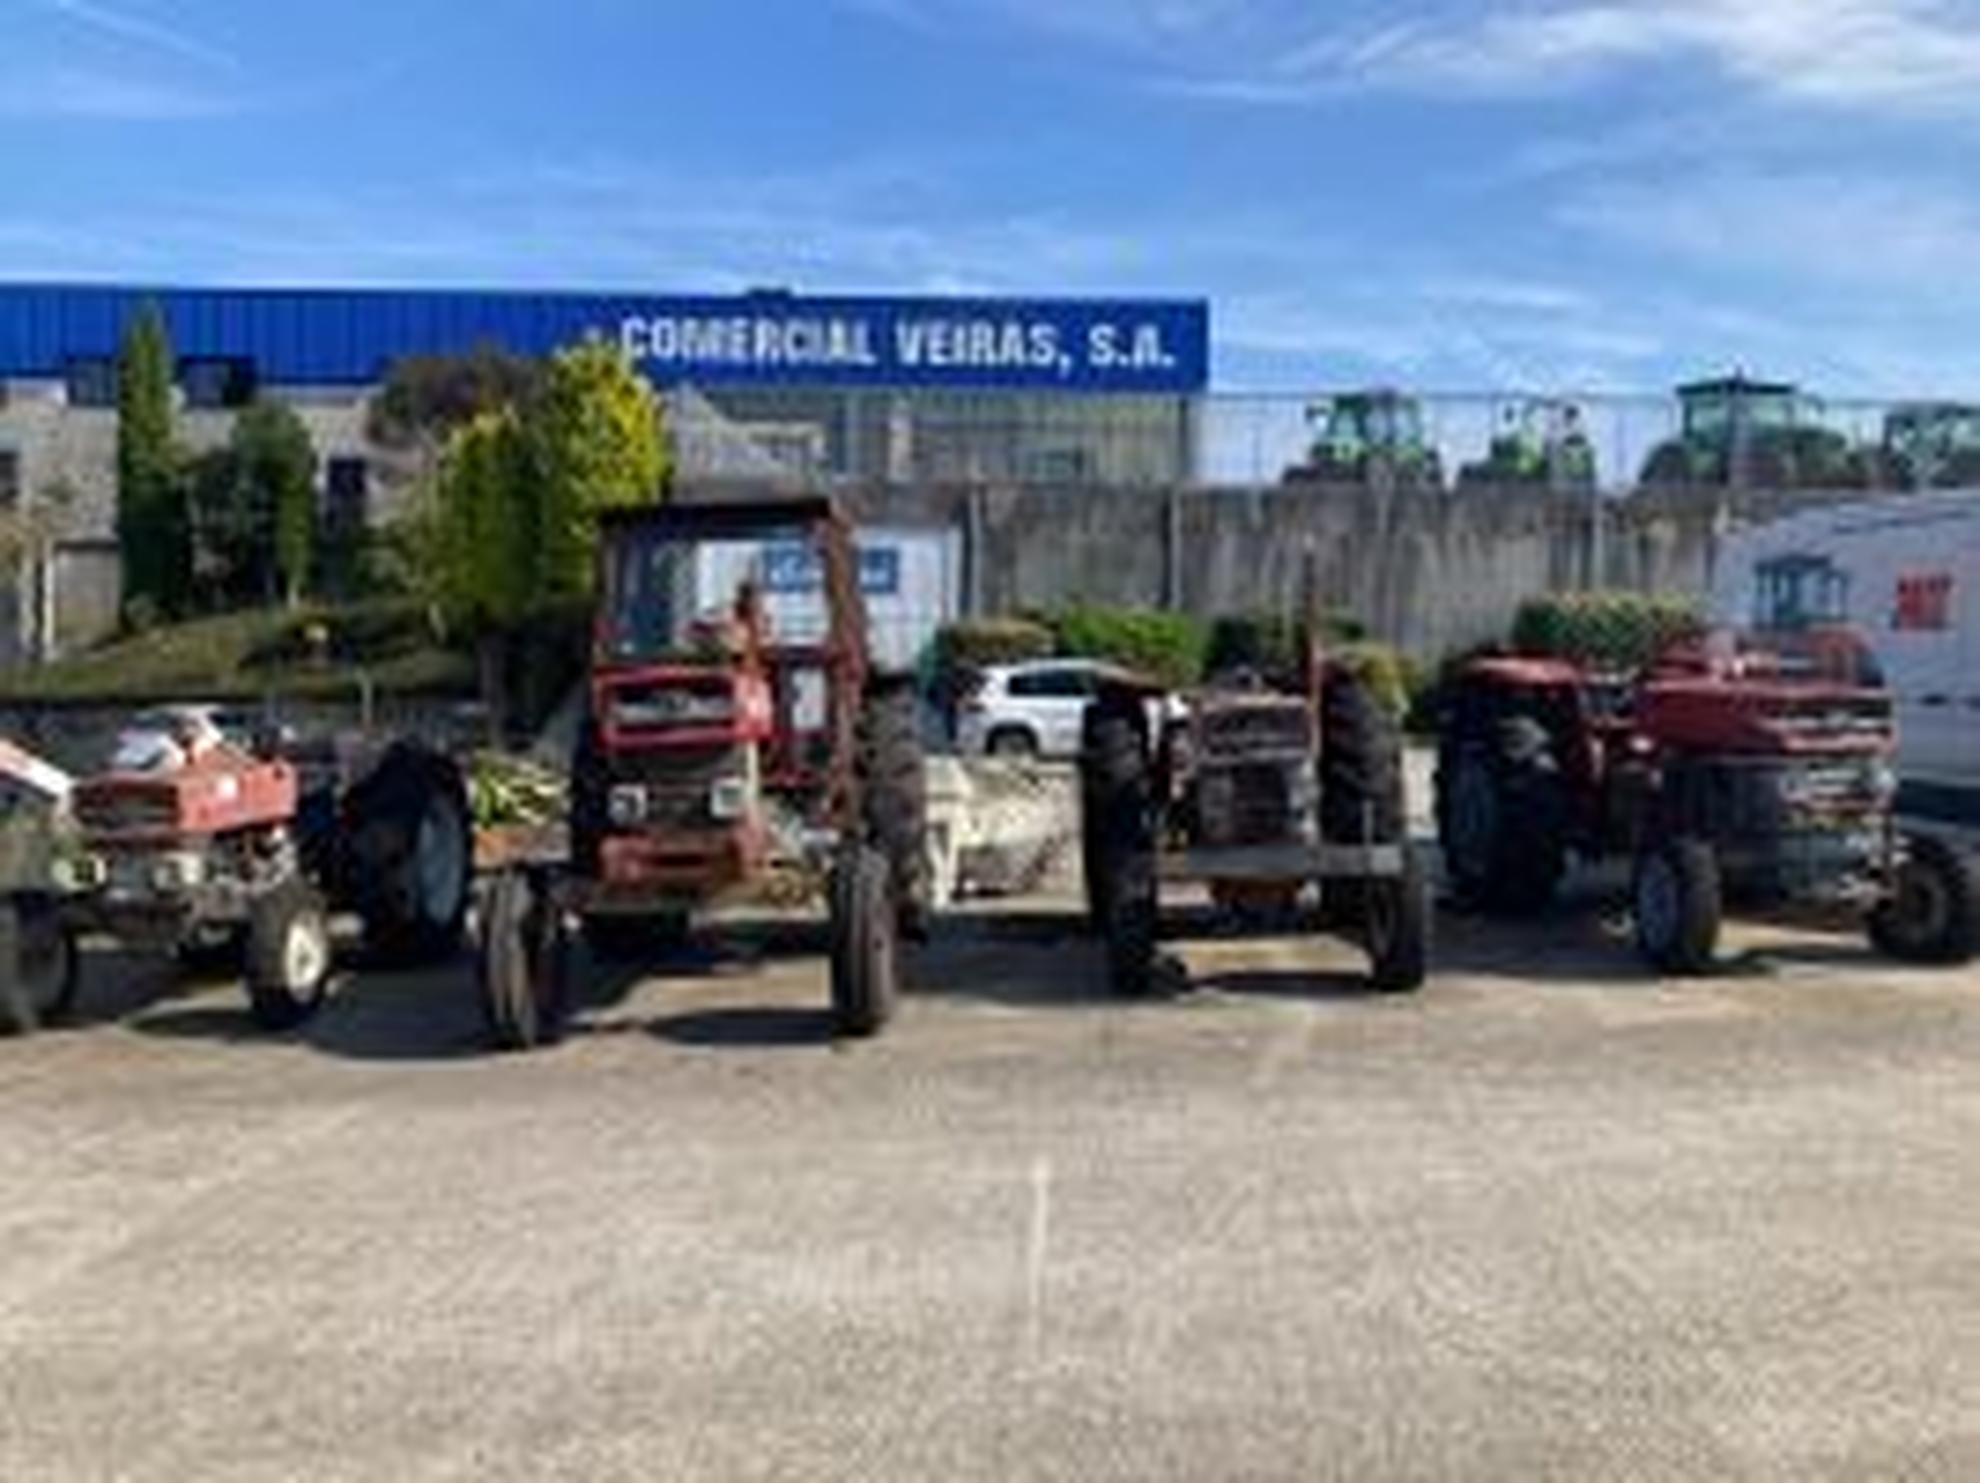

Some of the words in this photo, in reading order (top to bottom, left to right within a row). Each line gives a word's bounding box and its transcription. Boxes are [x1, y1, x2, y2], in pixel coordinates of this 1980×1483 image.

[621, 317, 877, 366] COMERCIAL
[896, 321, 1072, 378] VEIRAS,
[1088, 323, 1176, 368] S.A.
